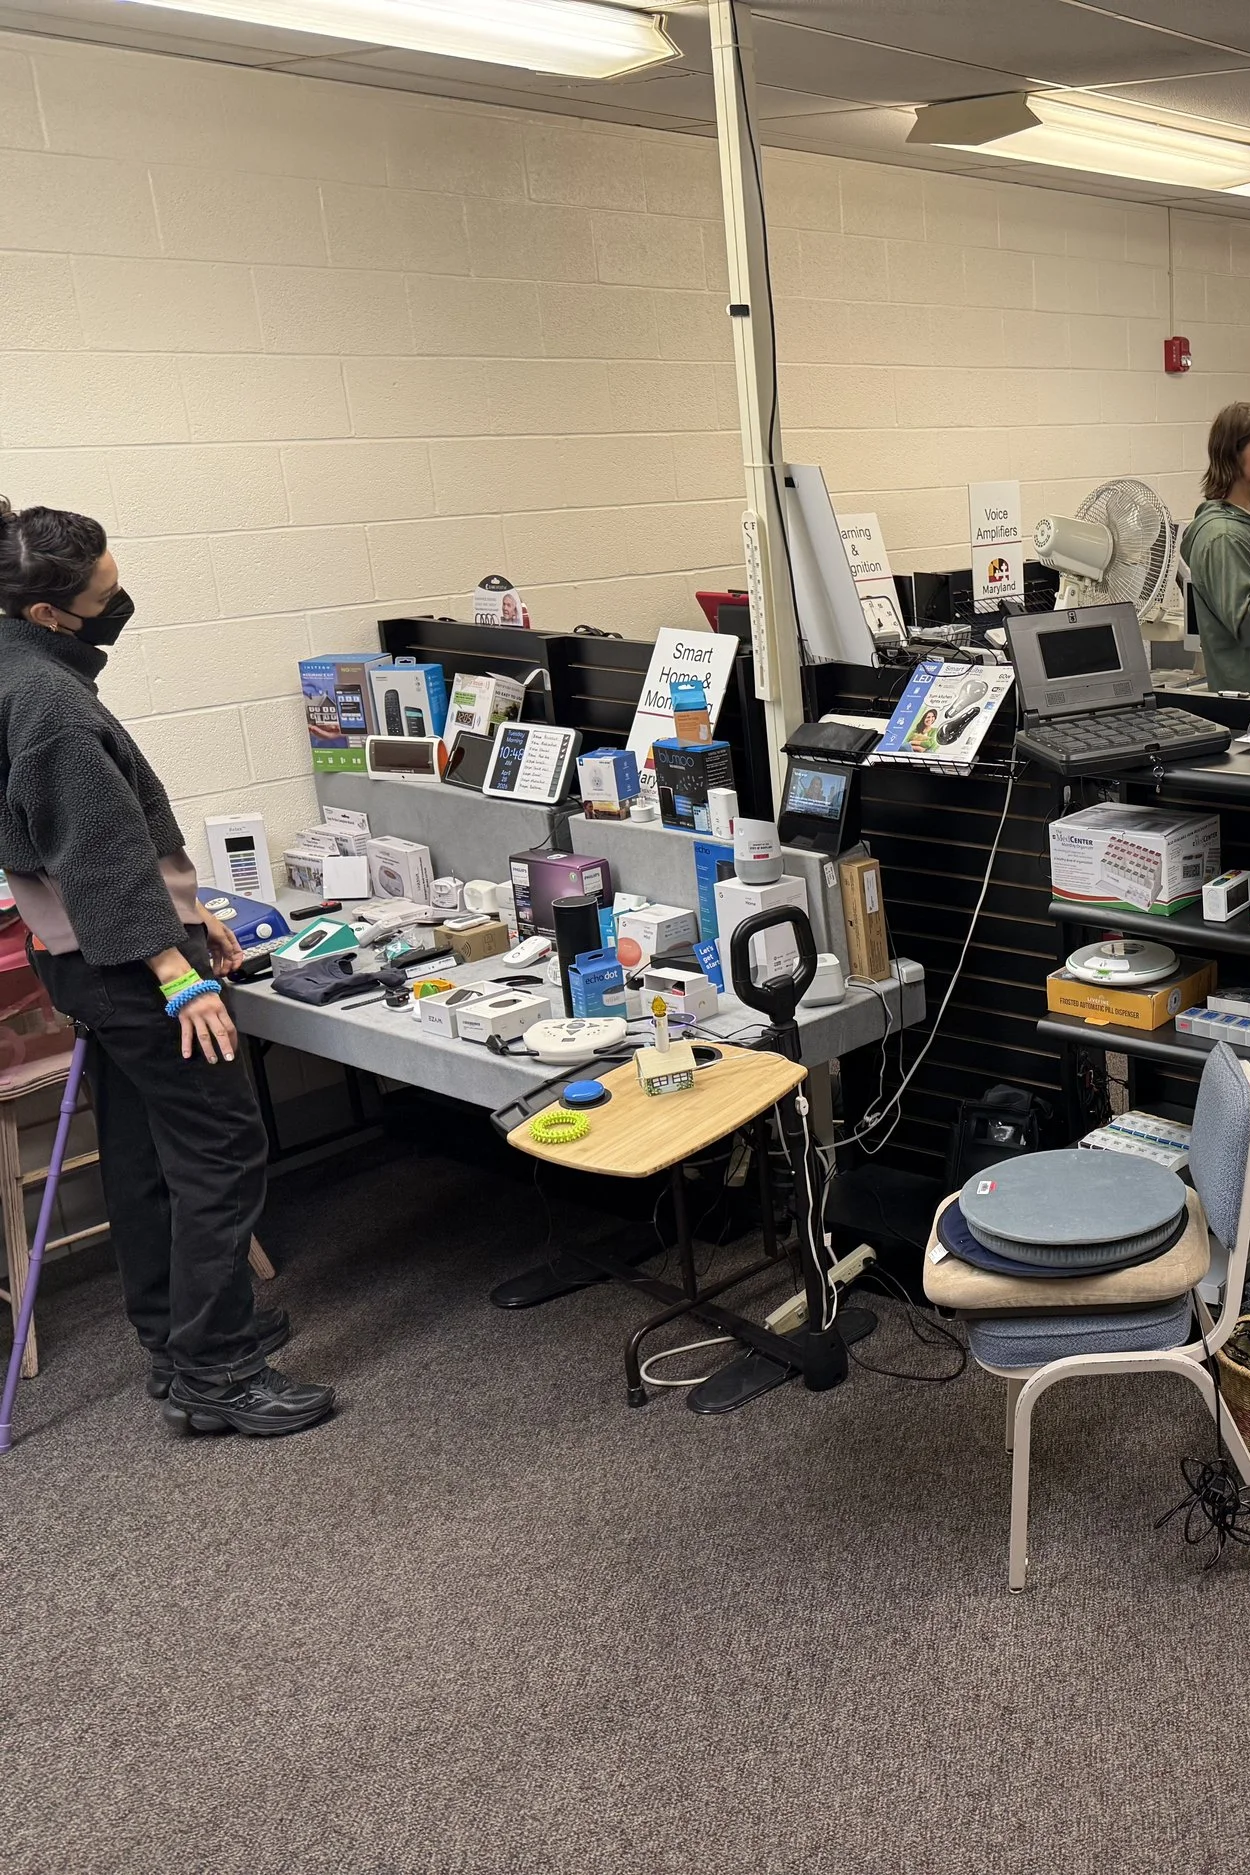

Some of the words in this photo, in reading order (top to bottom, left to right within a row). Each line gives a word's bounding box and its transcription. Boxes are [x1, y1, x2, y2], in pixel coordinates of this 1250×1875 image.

[984, 508, 1009, 521] Voice
[976, 525, 1018, 542] Amplifiers
[852, 544, 859, 556] &
[982, 581, 1016, 595] Maryland
[672, 642, 714, 664] Smart
[702, 672, 712, 690] &
[912, 674, 933, 683] LED
[507, 730, 526, 738] Tuesday
[506, 737, 524, 745] Morning
[500, 746, 526, 760] 10:48
[658, 749, 694, 767] blumoo
[584, 872, 600, 880] PHILIPS
[700, 945, 714, 955] Let's
[703, 954, 714, 964] get
[1060, 997, 1079, 1007] FROSTED
[1080, 1000, 1104, 1012] AUTOMATIC
[1105, 1005, 1114, 1015] PILL
[1115, 1007, 1140, 1019] DISPENSER
